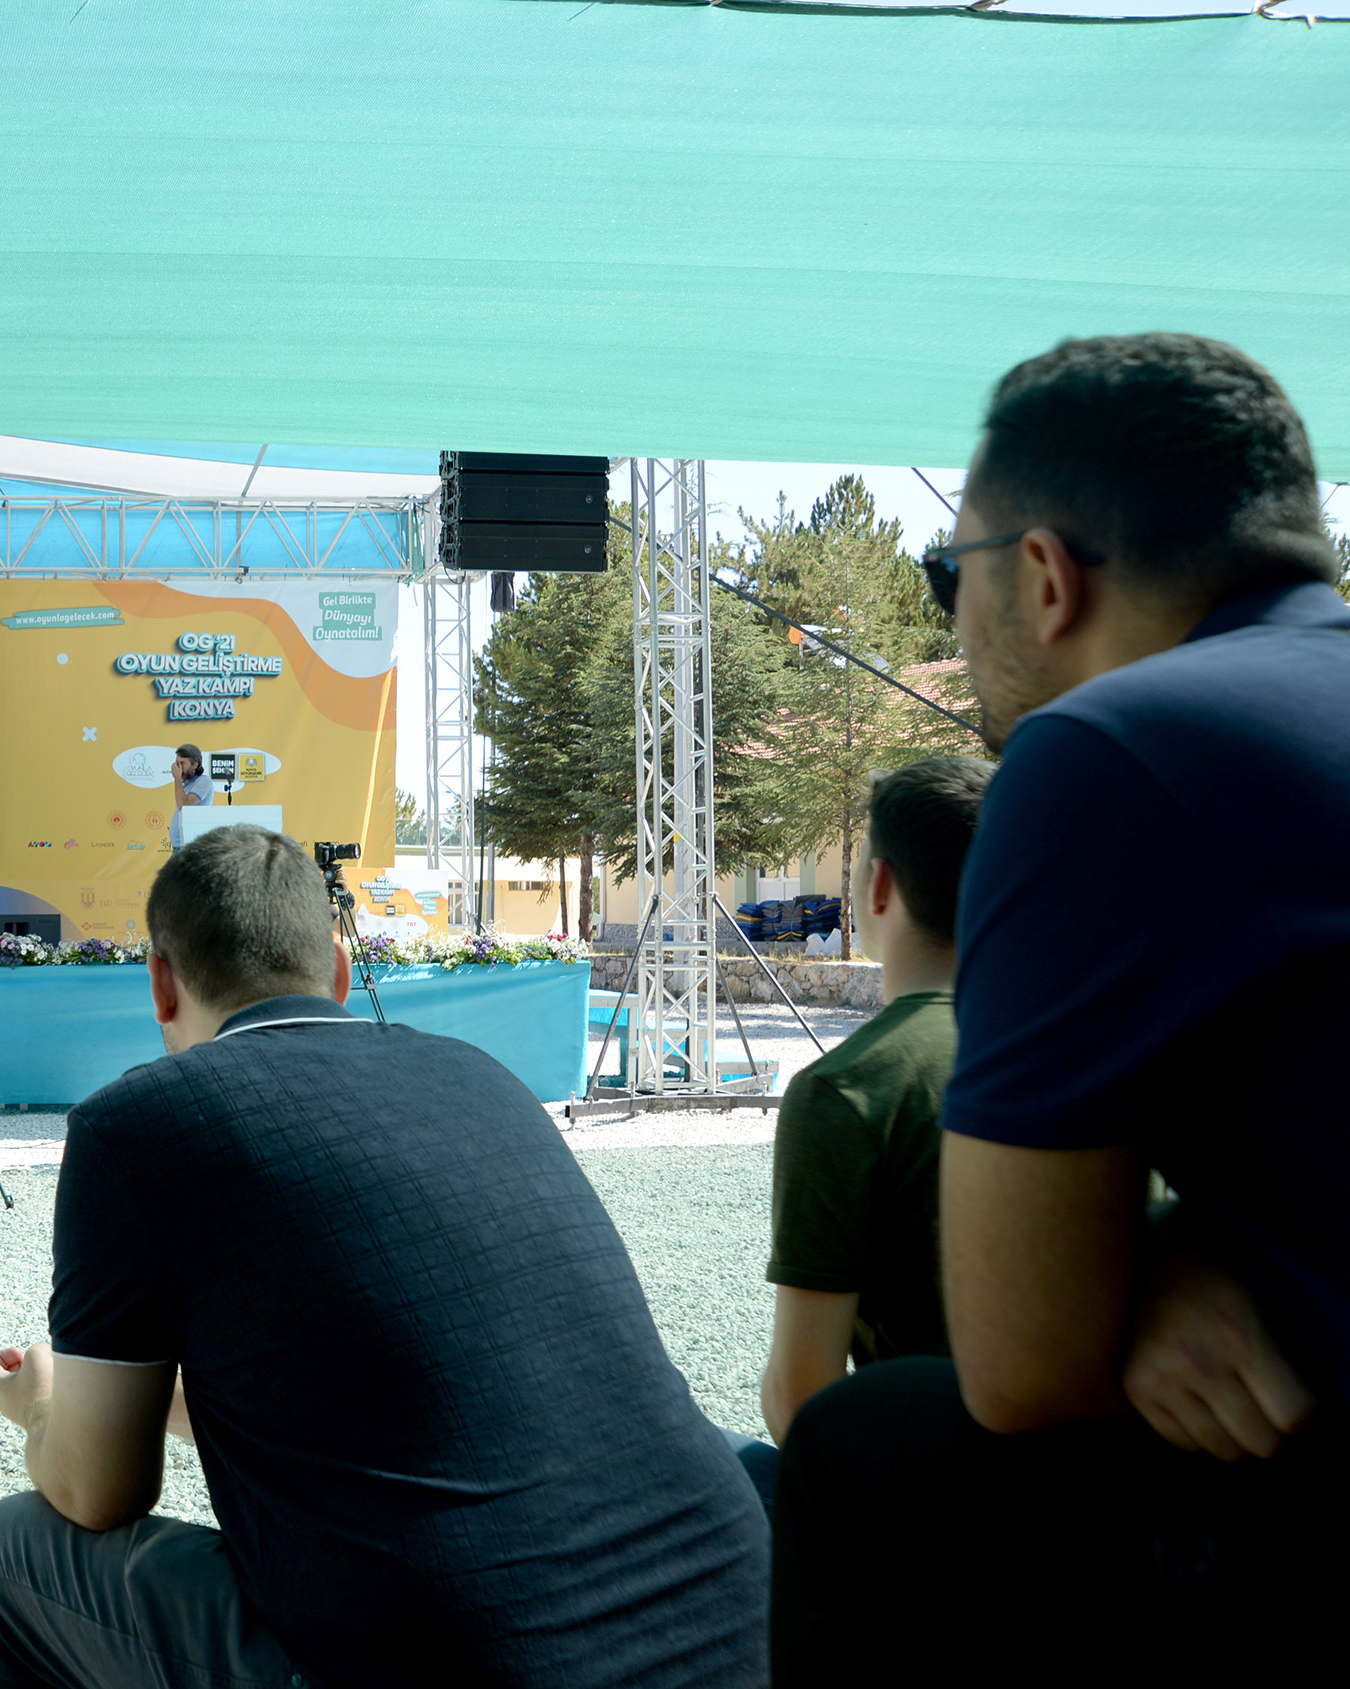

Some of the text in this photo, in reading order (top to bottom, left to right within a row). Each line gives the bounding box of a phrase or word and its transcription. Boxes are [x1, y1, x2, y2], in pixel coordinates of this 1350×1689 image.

[323, 595, 373, 606] Gel Birlikte
[15, 611, 115, 625] www.oyunlagelecek.com
[324, 609, 372, 626] Dünyayı
[181, 632, 214, 650] OG
[315, 626, 379, 641] Oynatalım!
[119, 652, 283, 675] OYUN GELİŞTİRME
[157, 677, 254, 694] YAZ KAMPI
[172, 700, 236, 717] KONYA
